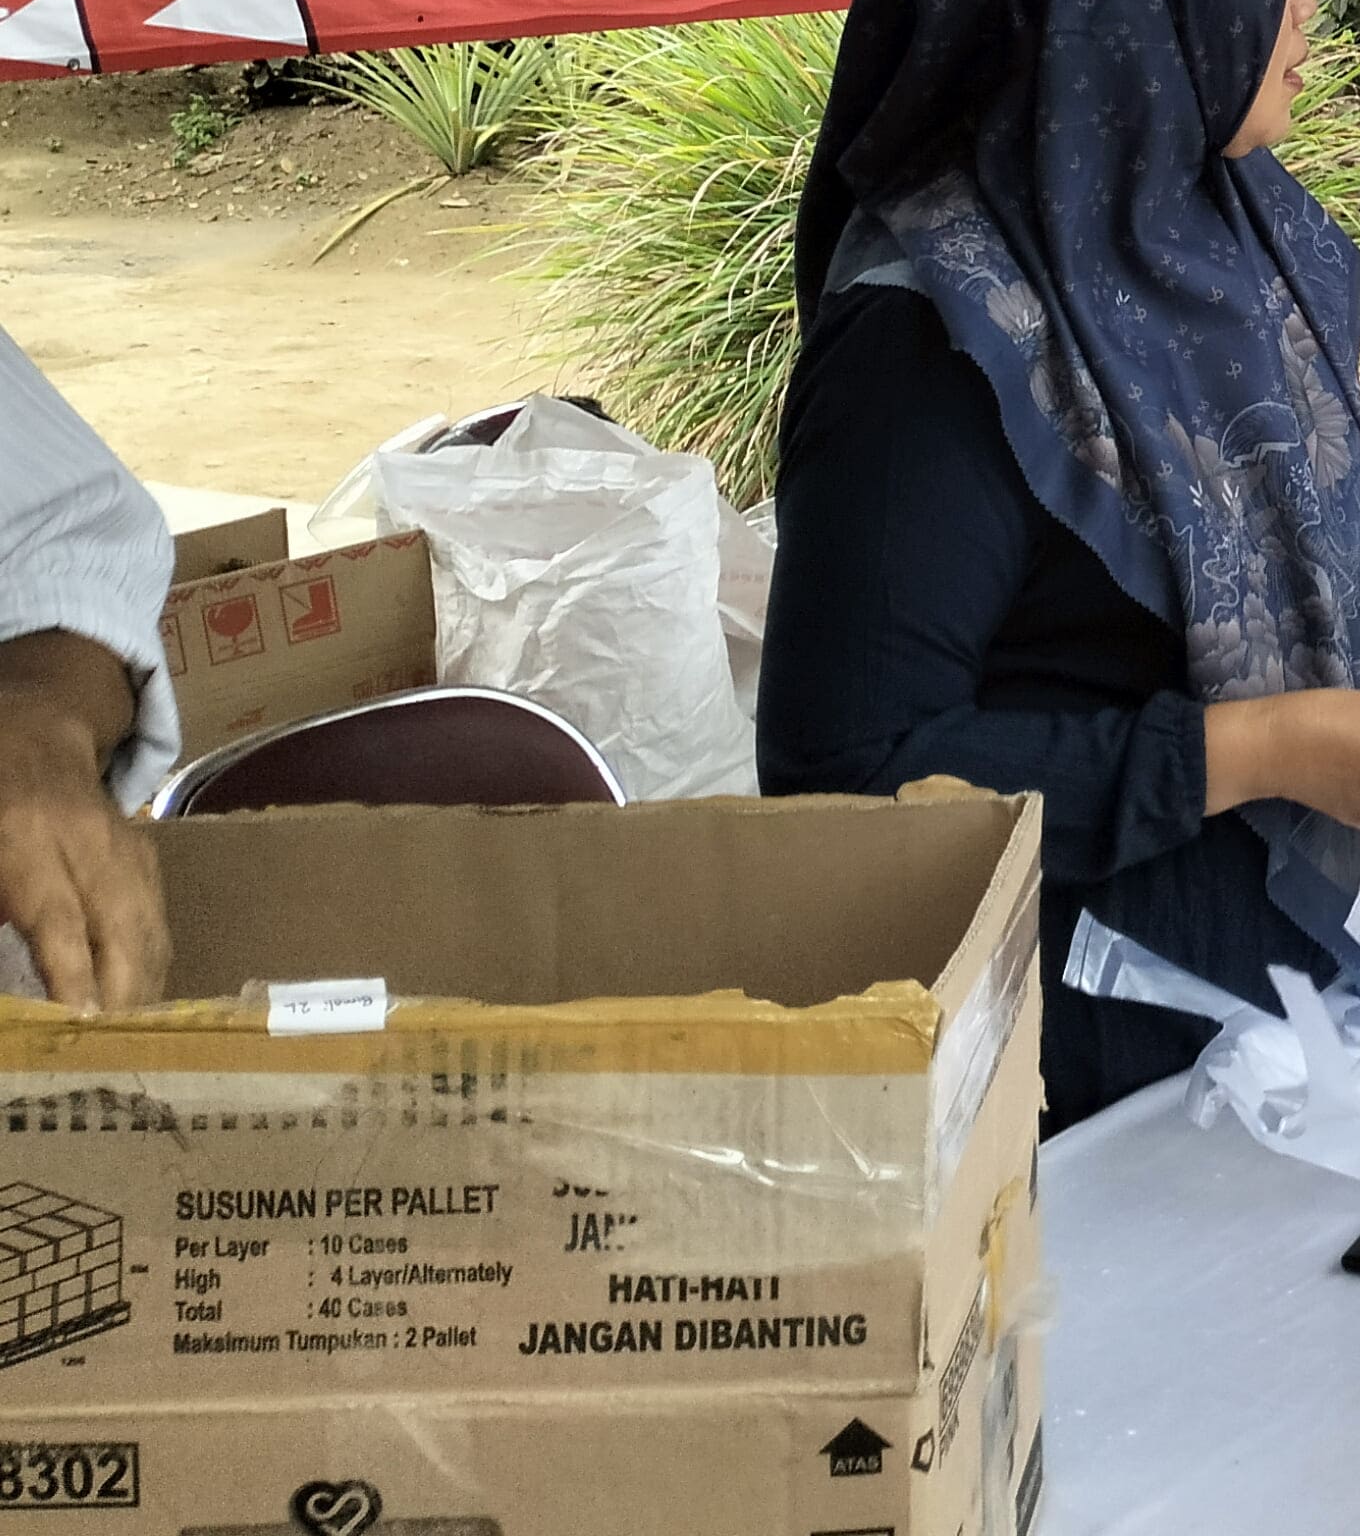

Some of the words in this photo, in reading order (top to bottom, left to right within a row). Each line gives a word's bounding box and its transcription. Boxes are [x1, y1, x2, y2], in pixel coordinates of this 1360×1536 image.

[176, 1190, 317, 1221] SUSUNAN
[325, 1188, 383, 1217] PER
[391, 1184, 500, 1215] PALLET
[175, 1236, 210, 1259] Per
[215, 1236, 271, 1262] Layer
[320, 1234, 343, 1255] 10
[349, 1234, 409, 1255] Cases
[175, 1268, 221, 1294] High
[331, 1266, 343, 1286] 4
[349, 1261, 514, 1291] Layer/Alternately
[608, 1273, 781, 1304] HATI-HATI
[175, 1300, 222, 1322] Total
[318, 1297, 342, 1319] 40
[348, 1297, 409, 1317] Cases
[174, 1331, 280, 1355] Maksimum
[286, 1329, 388, 1355] Tumpukan
[405, 1328, 417, 1348] 2
[423, 1327, 477, 1348] Pallet
[518, 1319, 663, 1356] JANGAN
[674, 1313, 868, 1352] DIBANTING
